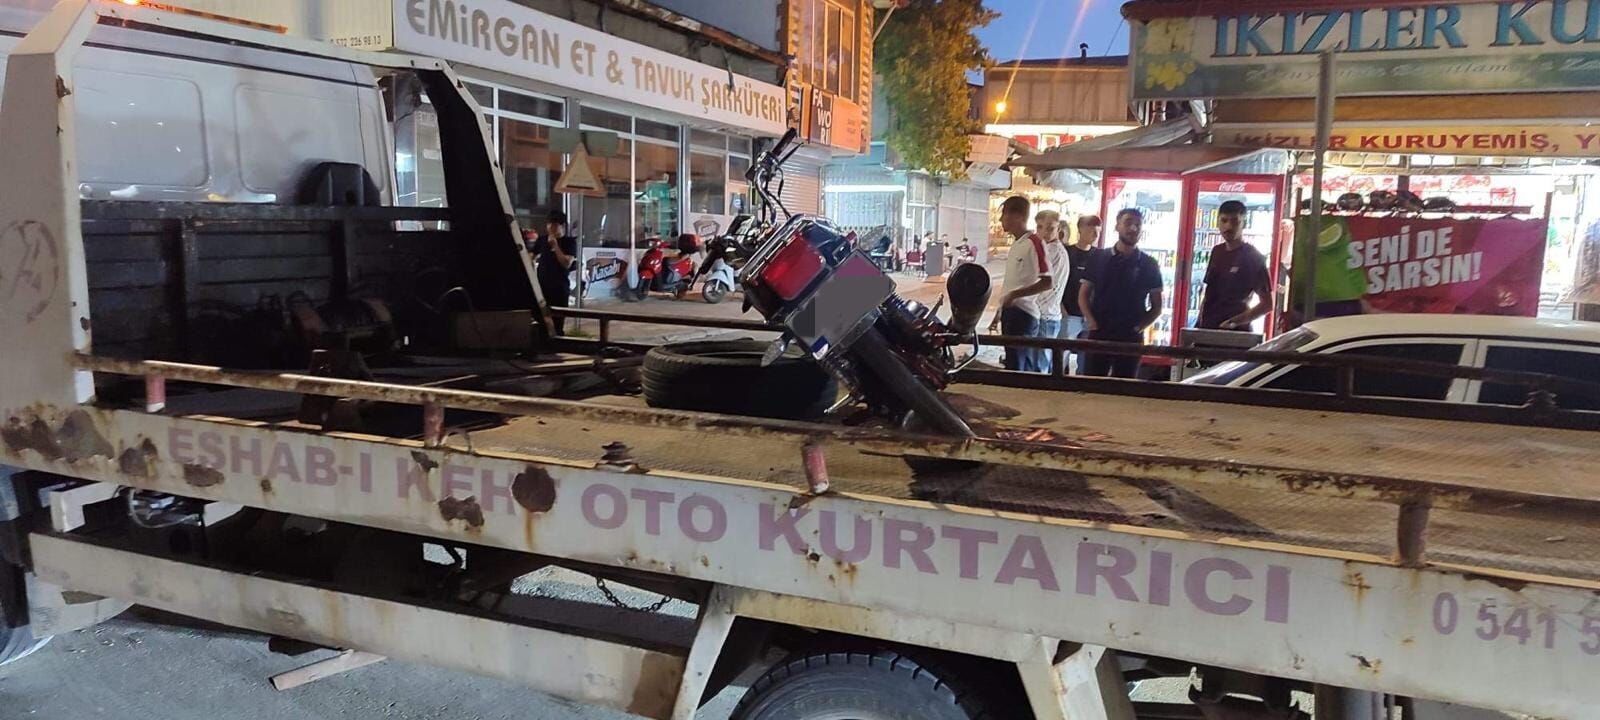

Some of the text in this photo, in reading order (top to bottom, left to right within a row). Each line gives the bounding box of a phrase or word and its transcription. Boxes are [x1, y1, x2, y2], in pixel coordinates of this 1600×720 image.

[570, 40, 597, 77] ET
[606, 50, 624, 85] &
[631, 56, 697, 102] TAVUK
[1575, 133, 1600, 150] Y
[1347, 225, 1453, 269] SENİ DE
[1366, 251, 1483, 294] SARSIN!
[167, 426, 1293, 624] ESHAB-I KEH OTO KURTARICI
[1432, 591, 1459, 635] 0
[1475, 597, 1558, 649] 541
